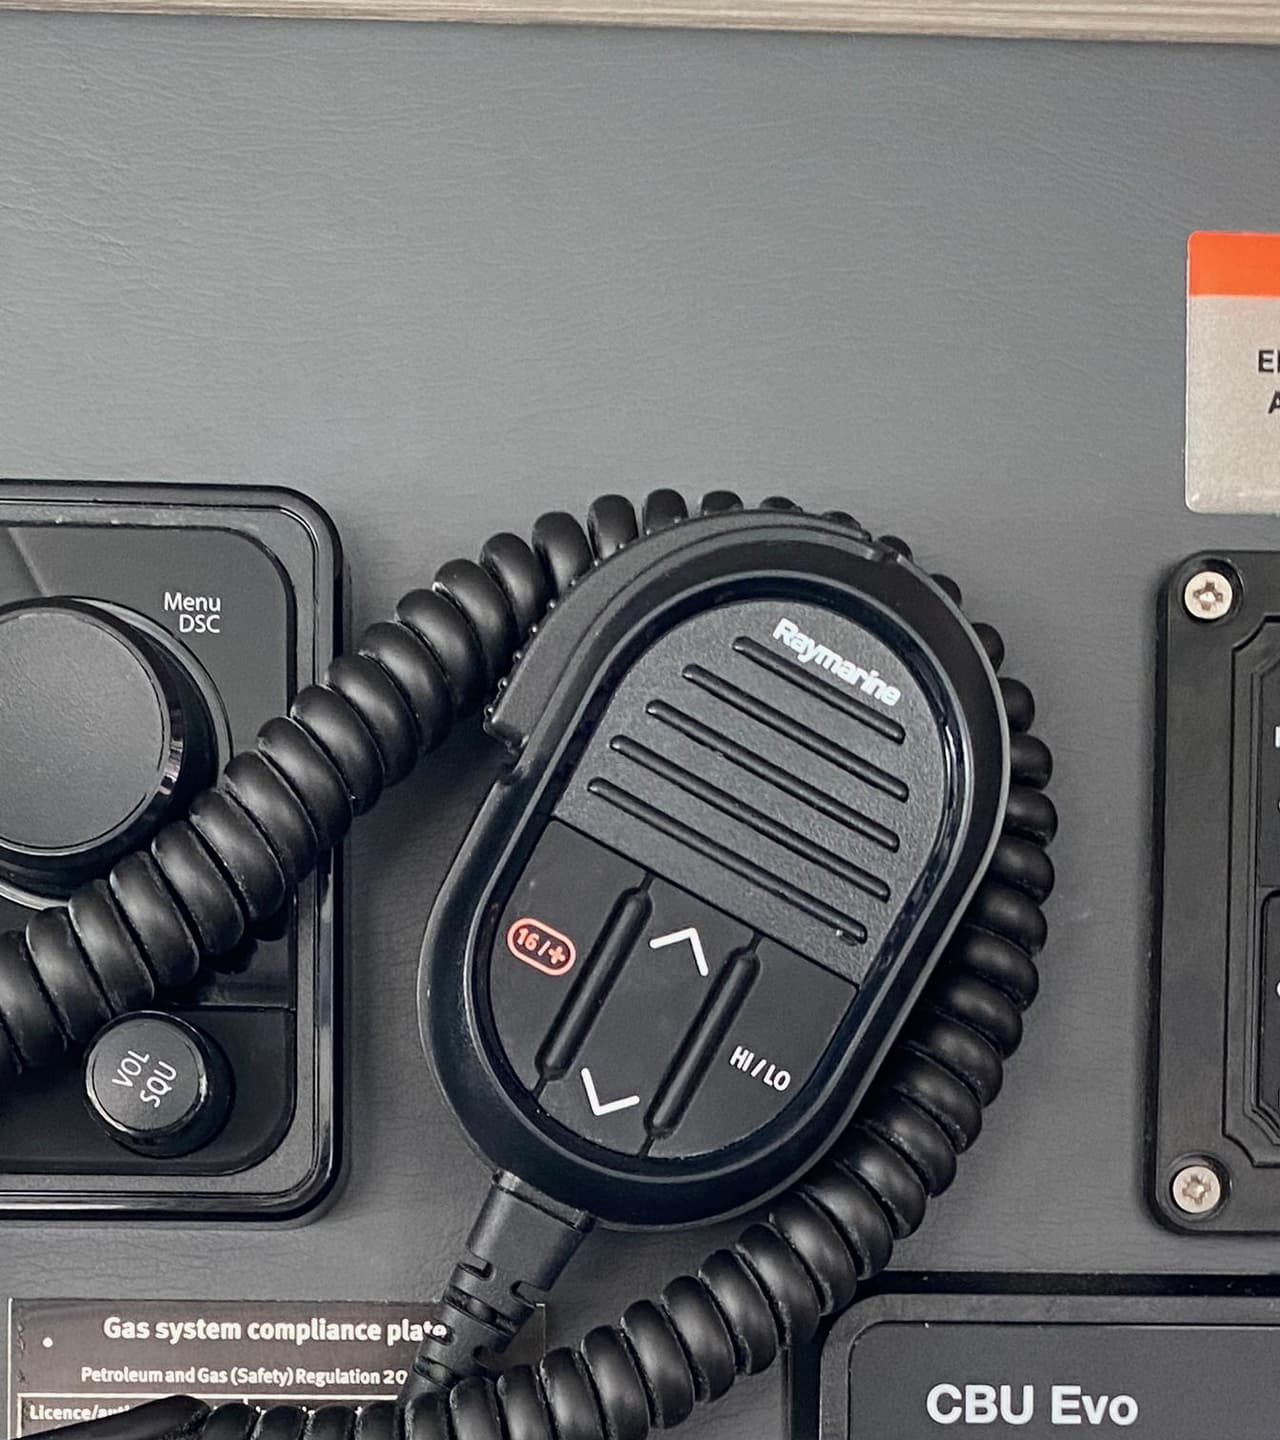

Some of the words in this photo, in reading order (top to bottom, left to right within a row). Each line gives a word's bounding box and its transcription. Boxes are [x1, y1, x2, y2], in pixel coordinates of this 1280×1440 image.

[164, 591, 221, 612] Menu
[179, 613, 221, 634] DSC
[772, 618, 901, 707] Raymarine
[111, 1049, 150, 1089] VOL
[140, 1061, 178, 1108] SQU
[103, 1316, 151, 1339] Gas
[154, 1318, 242, 1345] system
[247, 1317, 382, 1346] compliance
[81, 1365, 164, 1383] Petroleum
[164, 1366, 196, 1384] and
[196, 1367, 229, 1384] Gas
[230, 1366, 294, 1388] (Safety)
[295, 1367, 381, 1388] Regulation
[926, 1383, 1034, 1425] CBU
[1051, 1385, 1139, 1426] Evo
